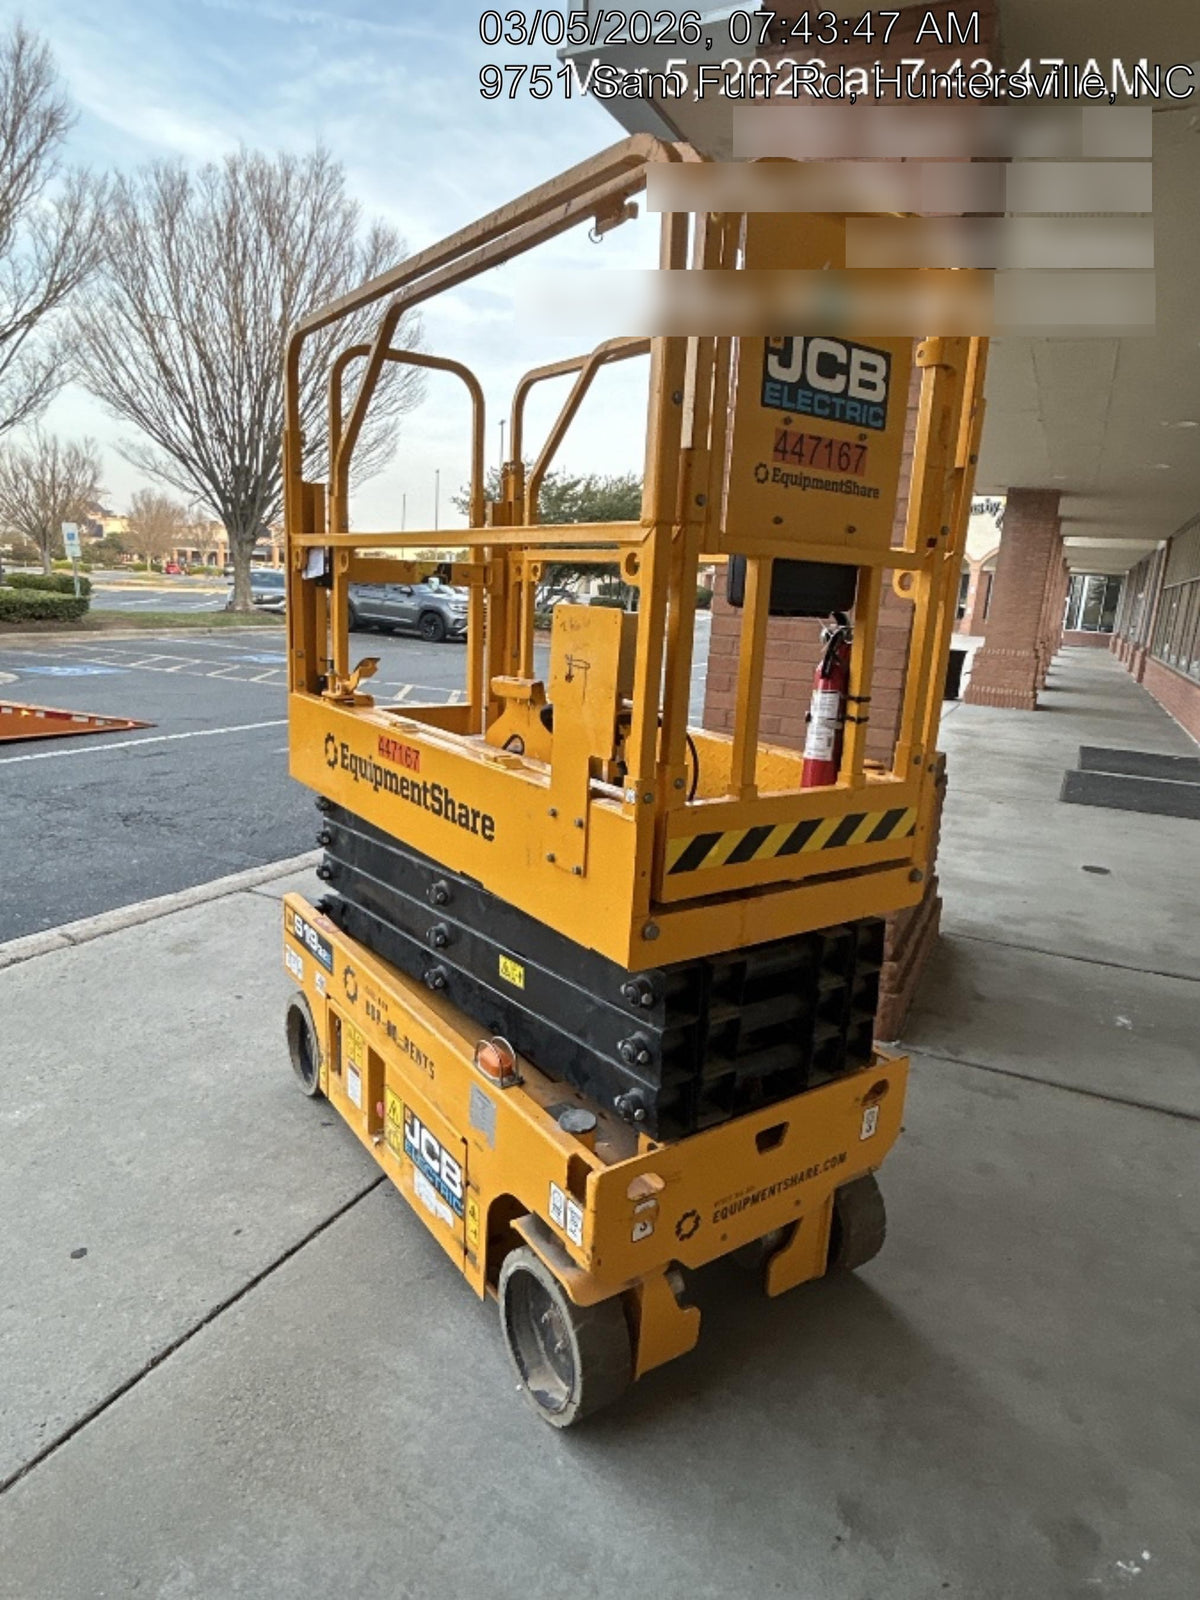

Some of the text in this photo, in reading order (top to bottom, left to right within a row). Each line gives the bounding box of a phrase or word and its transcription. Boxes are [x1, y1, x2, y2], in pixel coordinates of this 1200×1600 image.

[767, 336, 887, 403] JCB
[764, 382, 885, 428] ELECTRIC
[772, 467, 880, 499] EquipmentShare
[774, 430, 868, 474] 447167
[378, 735, 420, 773] 447167
[340, 742, 495, 842] EquipmentShare
[404, 1116, 463, 1199] JCB
[405, 1141, 463, 1216] ELECTRIC
[713, 1152, 848, 1224] EQUIPMENTSHARE.COM
